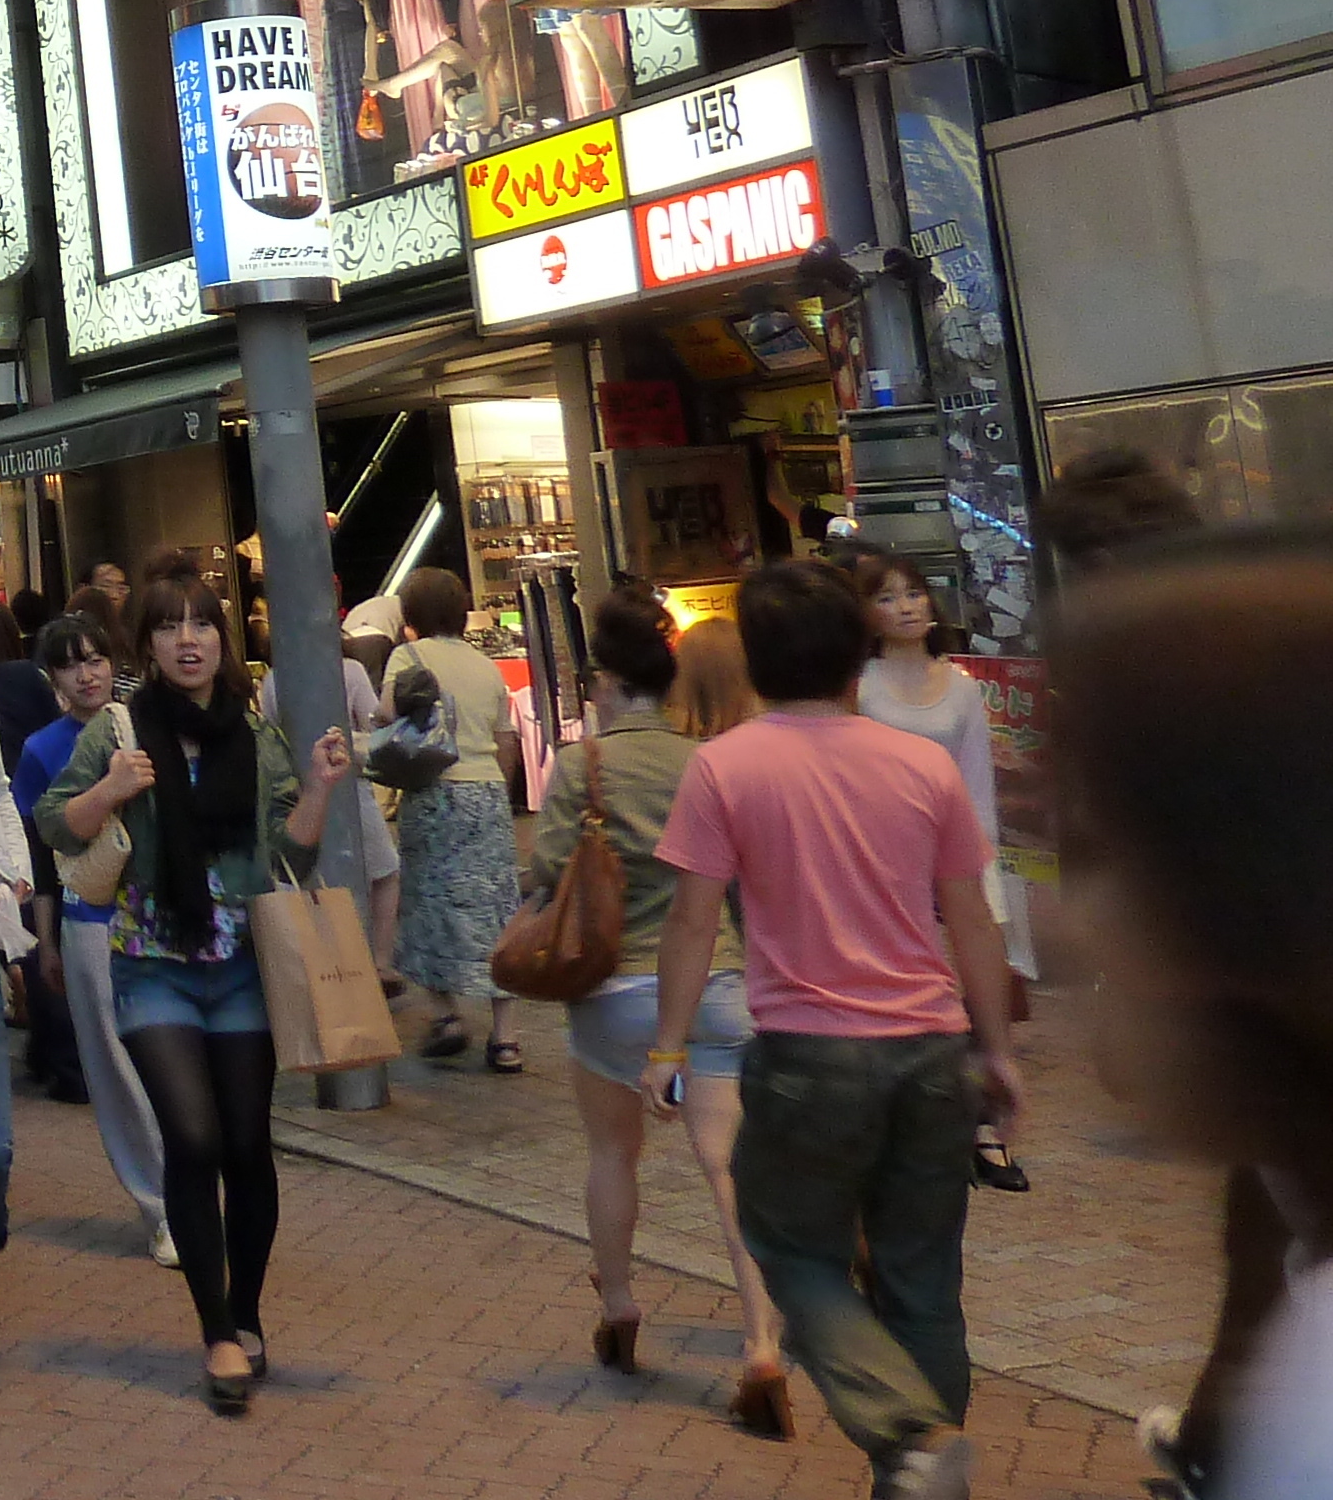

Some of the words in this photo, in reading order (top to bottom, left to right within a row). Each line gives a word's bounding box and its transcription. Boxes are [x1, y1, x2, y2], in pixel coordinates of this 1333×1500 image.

[210, 26, 295, 60] HAVE
[233, 149, 323, 201] 仙台
[469, 164, 490, 189] 4F
[646, 169, 816, 283] GASPANIC
